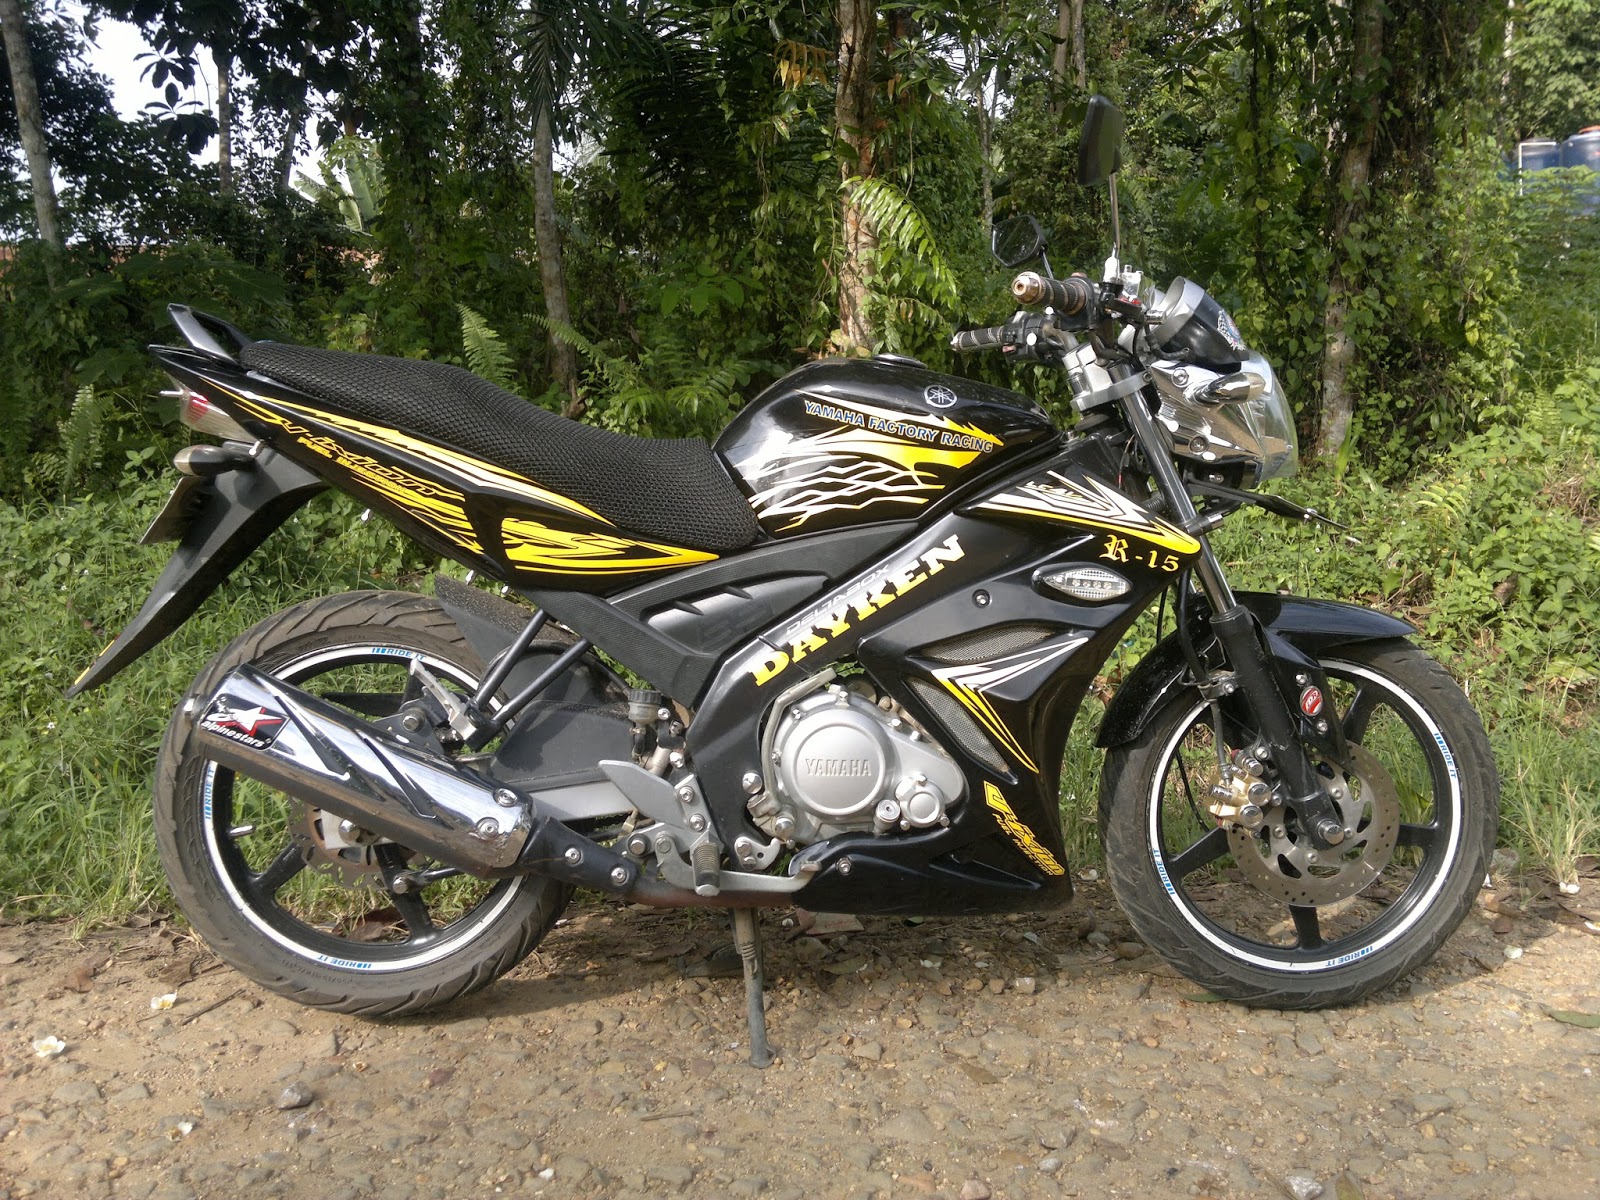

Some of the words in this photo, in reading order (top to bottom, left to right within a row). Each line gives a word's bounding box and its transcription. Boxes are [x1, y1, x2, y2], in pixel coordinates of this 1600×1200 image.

[804, 400, 865, 427] YAMAHA
[868, 417, 939, 441] FACTORY
[940, 433, 993, 453] RACING
[749, 534, 965, 687] DAYKEN
[387, 648, 412, 657] RIDE
[201, 720, 265, 748] alpinestars
[1440, 745, 1453, 766] RIDE
[805, 758, 872, 776] YAMAHA
[992, 813, 1013, 835] FUEL
